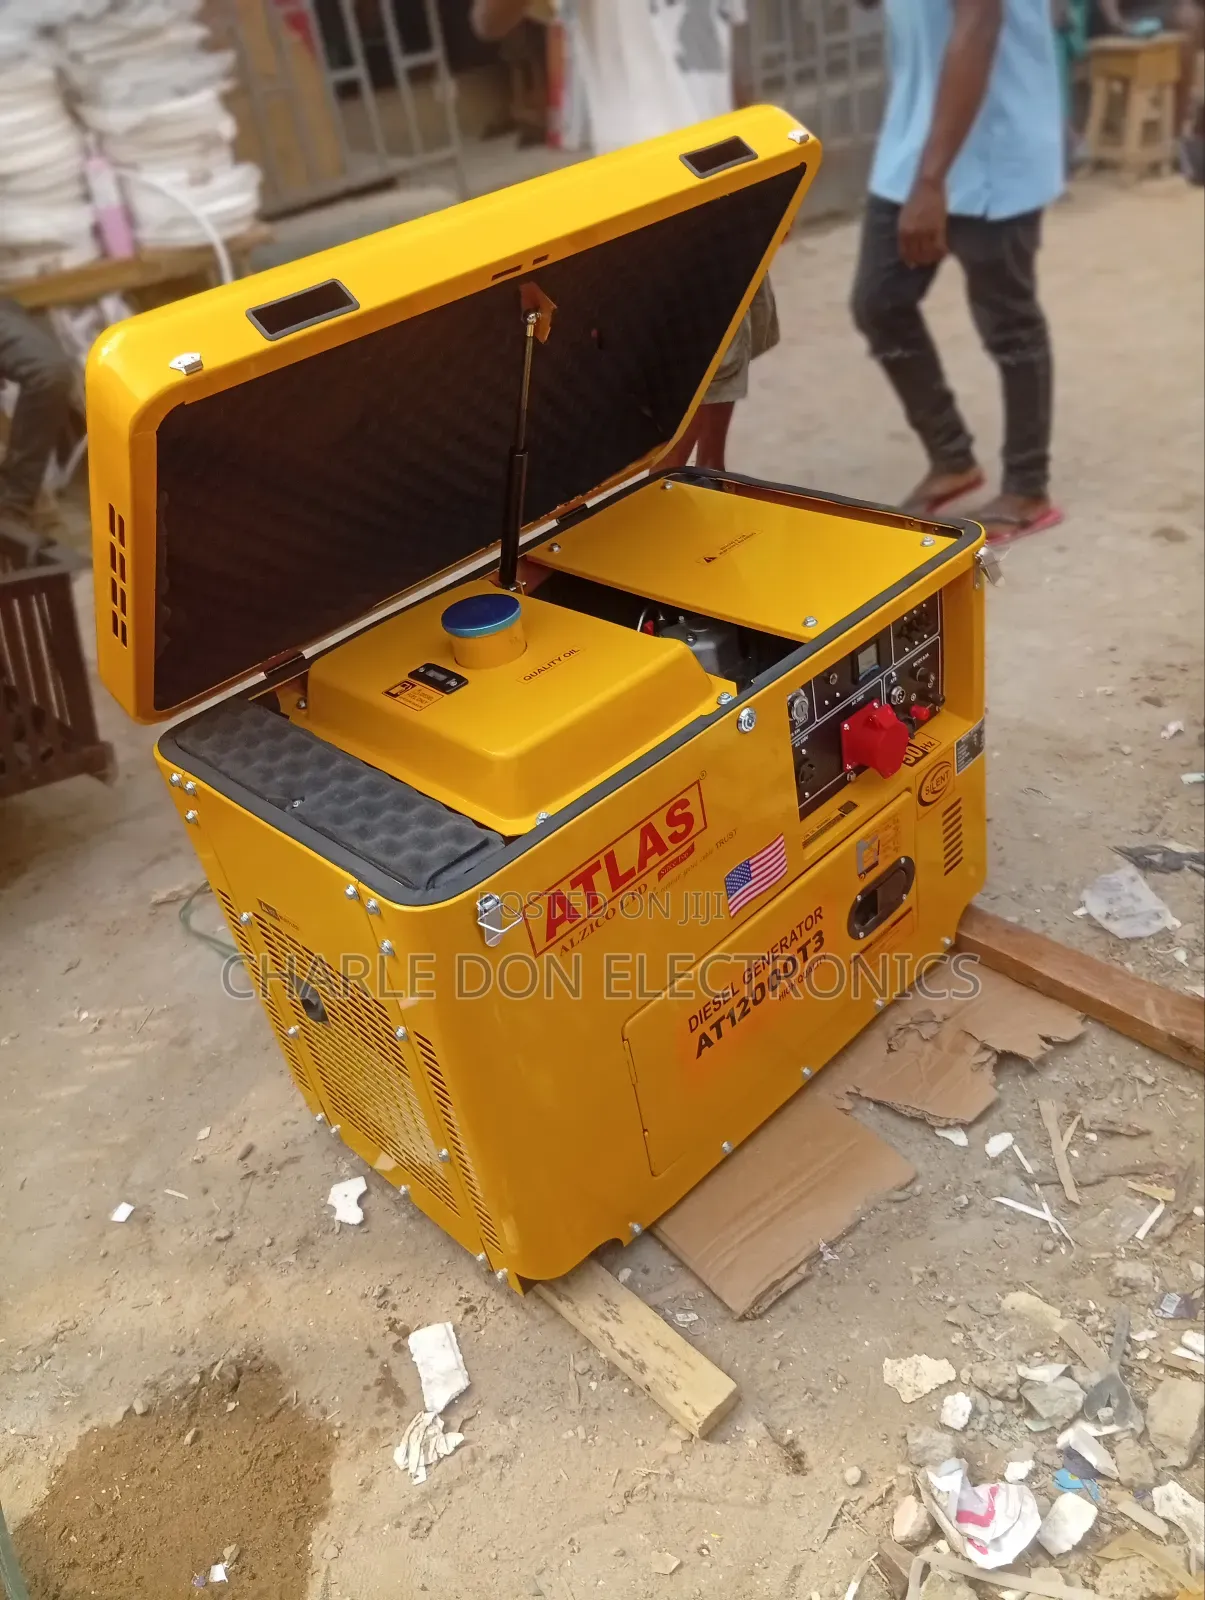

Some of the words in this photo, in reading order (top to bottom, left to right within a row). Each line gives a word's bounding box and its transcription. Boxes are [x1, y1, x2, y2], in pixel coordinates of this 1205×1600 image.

[523, 656, 562, 682] QUALITY
[563, 648, 580, 658] OIL
[920, 740, 936, 751] Hz
[925, 769, 950, 796] SILENT
[715, 827, 739, 850] TRUST
[545, 797, 695, 943] ATLAS
[559, 907, 616, 958] ALZICO
[619, 883, 649, 912] LTD
[688, 981, 740, 1034] DIESEL
[742, 905, 824, 986] GENERATOR
[695, 929, 825, 1060] AT12000T3
